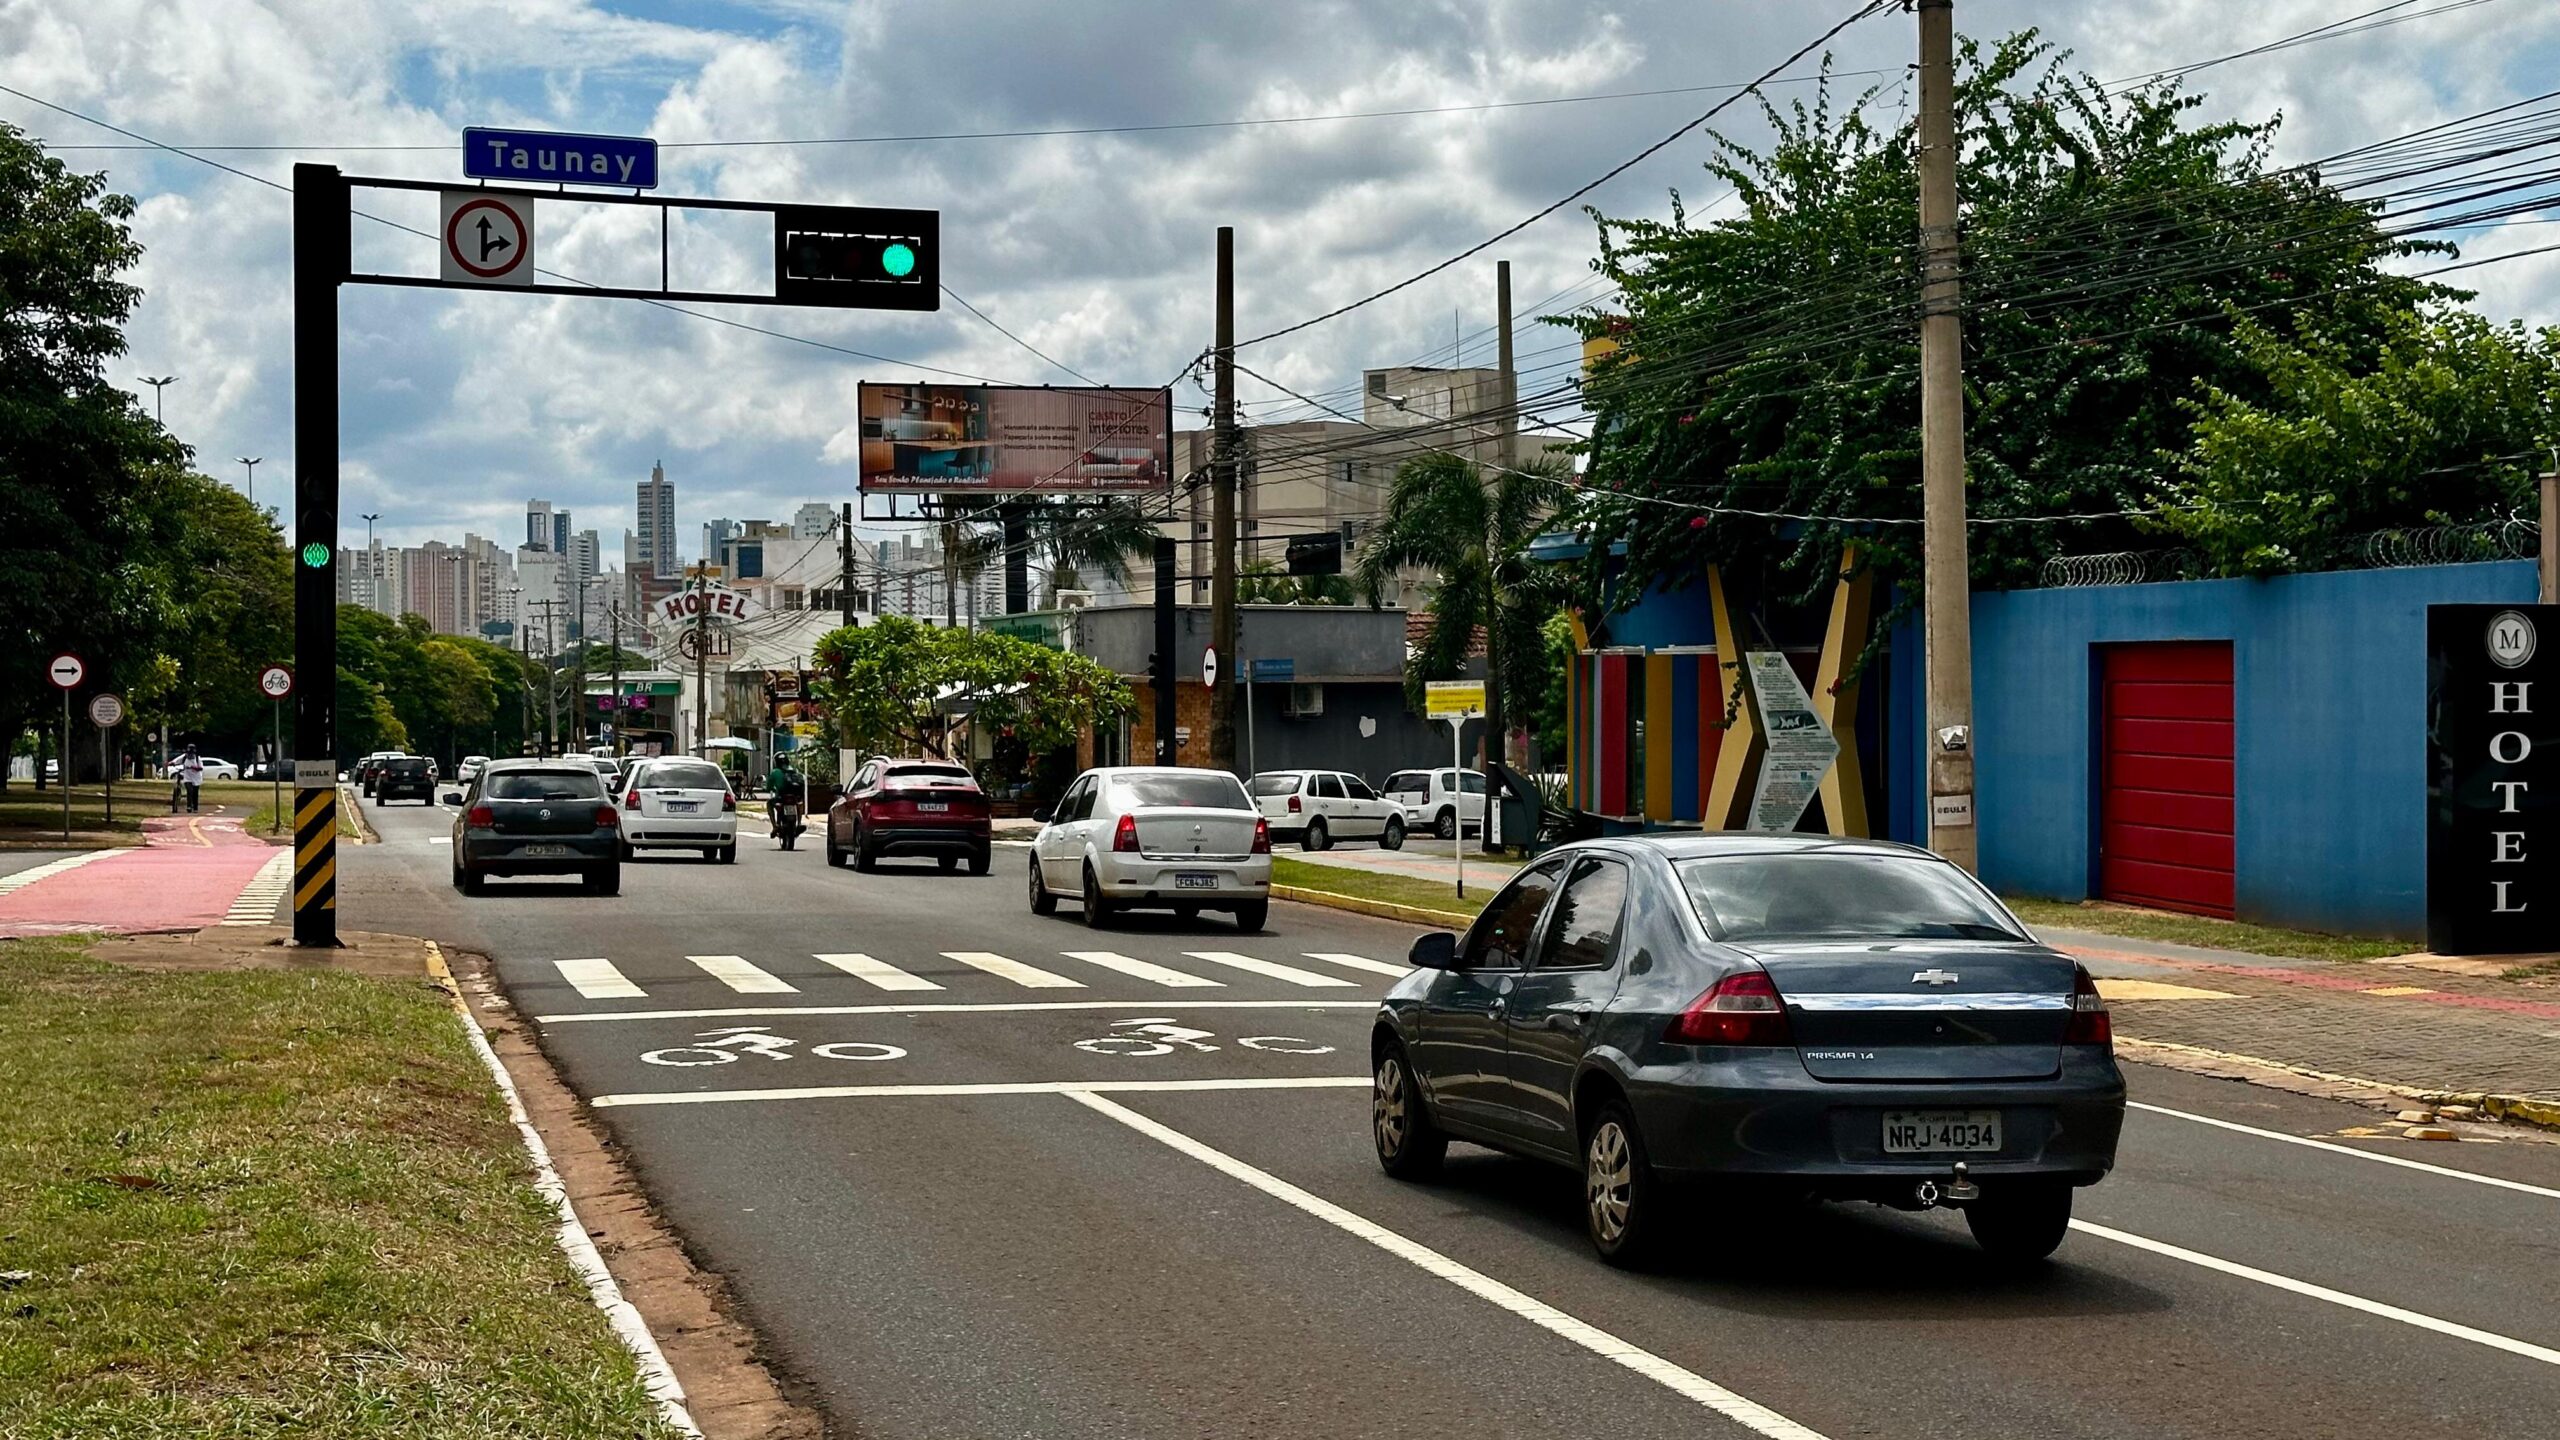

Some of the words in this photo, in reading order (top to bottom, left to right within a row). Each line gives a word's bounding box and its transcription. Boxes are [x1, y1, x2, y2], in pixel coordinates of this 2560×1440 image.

[488, 140, 636, 182] Taunay
[665, 593, 746, 620] HOTEL
[636, 683, 652, 692] BR
[2488, 682, 2533, 912] HOTEL
